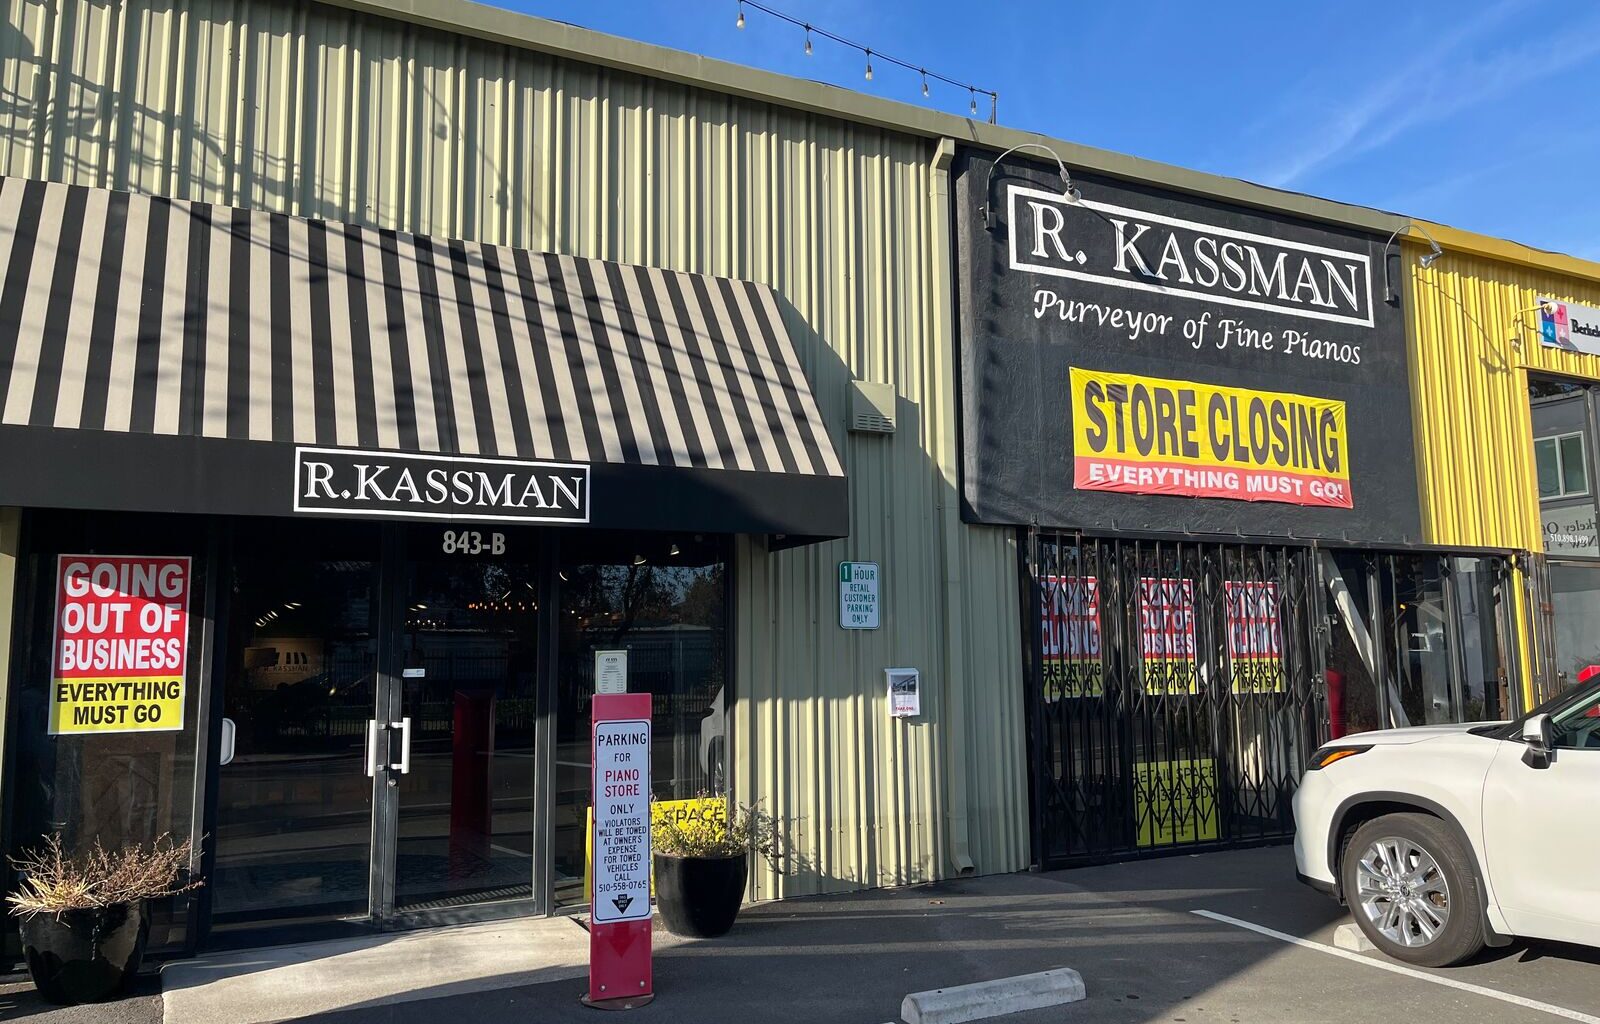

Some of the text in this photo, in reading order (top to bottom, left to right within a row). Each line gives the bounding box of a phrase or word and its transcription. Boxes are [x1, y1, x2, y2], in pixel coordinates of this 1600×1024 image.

[1028, 201, 1357, 311] R. KASSMAN
[1034, 290, 1361, 364] Purveyor of Fine Pianos
[1085, 380, 1340, 473] STORE CLOSING
[1089, 463, 1343, 499] EVERYTHING MUST GO!
[443, 531, 505, 555] 843-B
[844, 566, 874, 580] 1 HOUR
[63, 562, 183, 598] GOING
[850, 584, 869, 592] RETAIL
[844, 594, 875, 602] CUSTOMER
[847, 604, 873, 612] PARKING
[61, 602, 181, 634] OUT OF
[852, 614, 868, 623] ONLY
[1142, 610, 1192, 630] OUT OF
[59, 638, 181, 671] BUSINESS
[57, 681, 180, 702] EVERYTHING
[73, 704, 161, 725] MUST GO
[598, 732, 647, 746] PARKING
[614, 752, 631, 762] FOR
[605, 769, 639, 783] PIANO
[604, 784, 640, 797] STORE
[610, 804, 634, 815] ONLY
[605, 818, 641, 828] VIOLATORS
[626, 826, 646, 834] TOWED
[614, 835, 642, 845] OWNER'S
[608, 845, 637, 854] EXPENSE
[604, 854, 641, 864] FOR TOWED
[607, 863, 638, 873] VEHICLES
[599, 880, 647, 892] 510-558-0765
